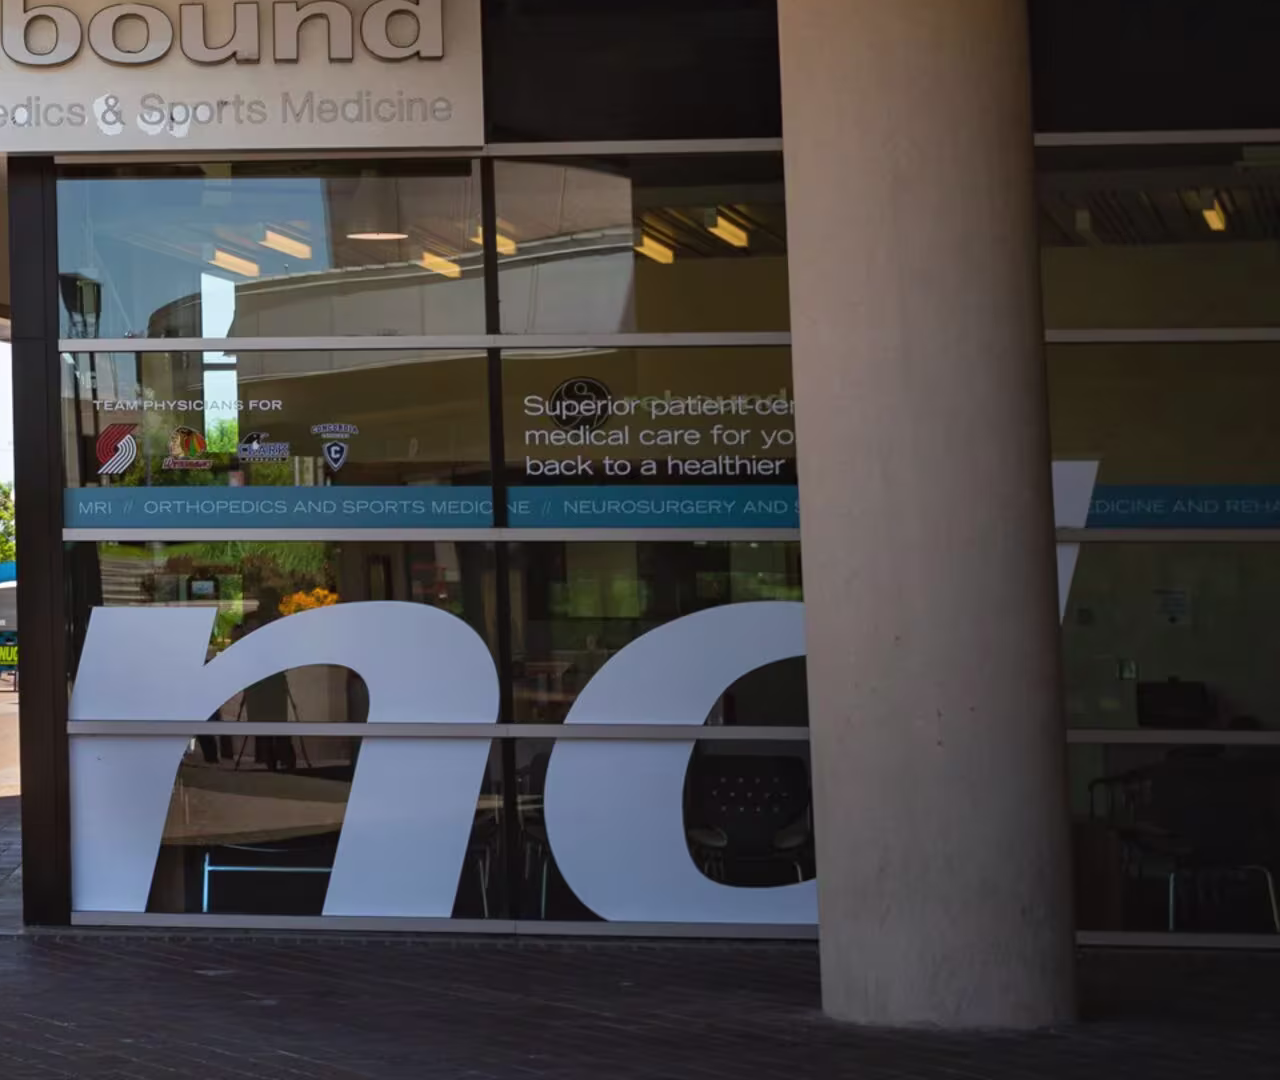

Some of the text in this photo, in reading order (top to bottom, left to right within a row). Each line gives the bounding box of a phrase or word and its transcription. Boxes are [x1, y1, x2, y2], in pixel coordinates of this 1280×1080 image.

[100, 94, 126, 126] &
[141, 92, 267, 131] Sports
[282, 90, 453, 122] Medicine
[93, 400, 282, 411] TEAM PHYSICIANS FOR
[524, 395, 640, 419] Superior
[525, 426, 629, 445] medical
[639, 429, 701, 445] care
[710, 425, 750, 445] for
[525, 455, 786, 475] back to a healthier
[78, 501, 112, 514] MRI
[144, 500, 288, 514] ORTHOPEDICS
[293, 501, 337, 514] AND
[342, 500, 425, 514] SPORTS
[564, 500, 737, 514] NEUROSURGERY
[743, 500, 789, 514] AND
[1172, 499, 1219, 514] AND
